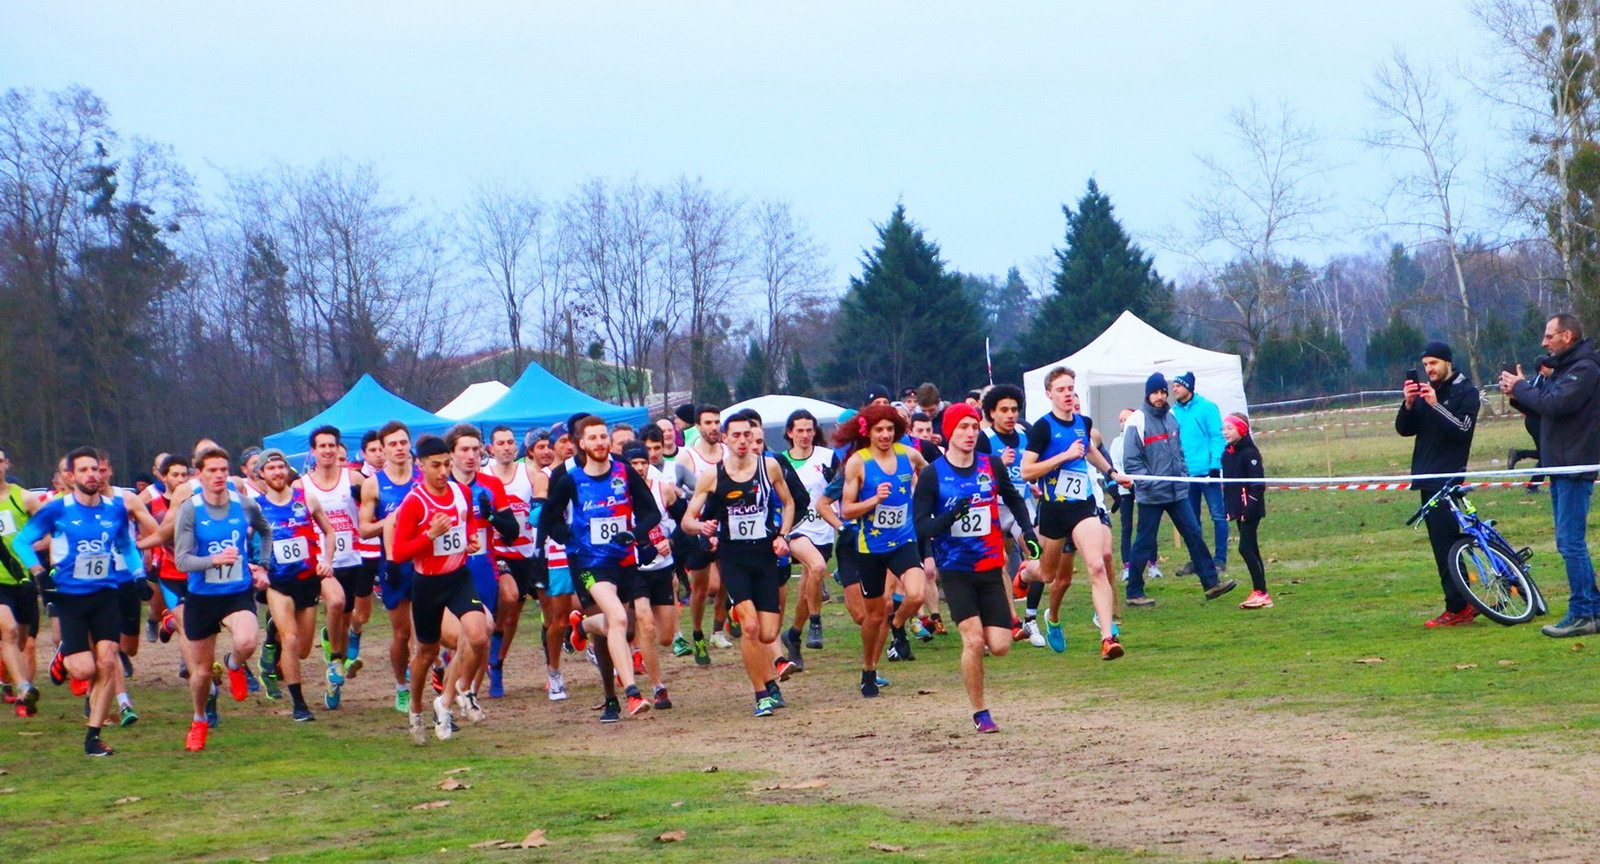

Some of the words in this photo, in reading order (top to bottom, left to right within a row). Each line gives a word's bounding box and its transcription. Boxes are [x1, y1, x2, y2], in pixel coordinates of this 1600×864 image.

[1065, 477, 1082, 495] 73
[601, 522, 619, 540] 89
[738, 520, 756, 536] 67
[961, 514, 982, 533] 82
[336, 537, 345, 552] 9
[443, 532, 461, 551] 56
[282, 543, 301, 560] 86
[85, 560, 104, 576] 16
[215, 563, 234, 580] 17
